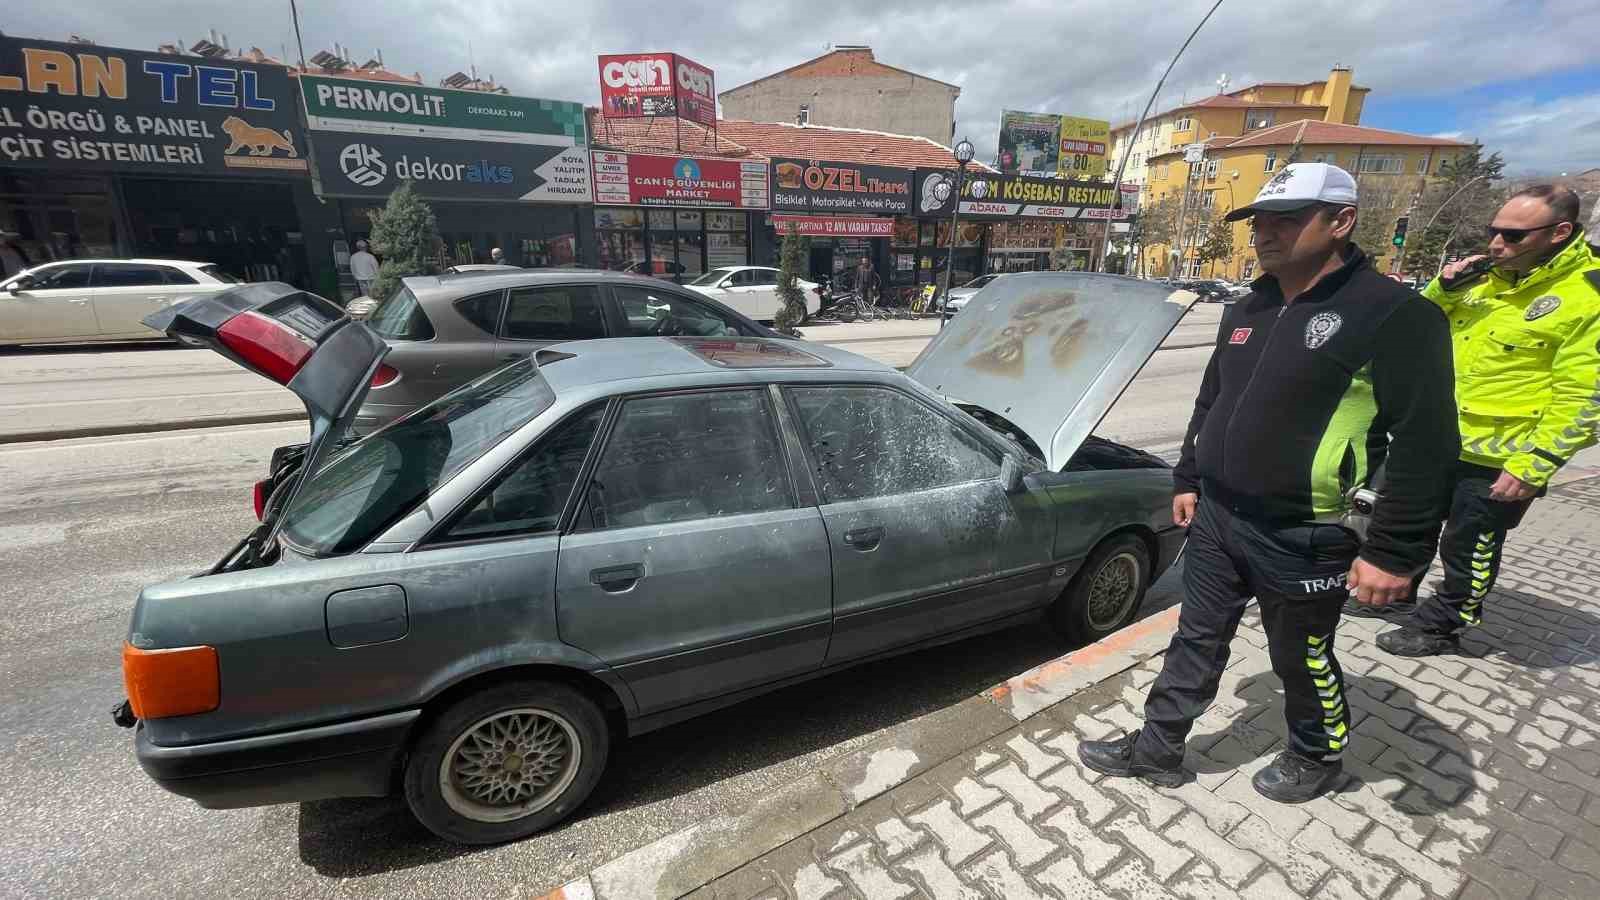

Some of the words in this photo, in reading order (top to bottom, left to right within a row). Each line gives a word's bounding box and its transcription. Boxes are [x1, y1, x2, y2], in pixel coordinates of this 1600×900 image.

[603, 59, 670, 88] can
[143, 60, 275, 111] TEL
[26, 105, 106, 132] ÖRGÜ
[115, 115, 134, 134] &
[137, 116, 215, 139] PANEL
[0, 133, 44, 160] ÇİT
[52, 136, 204, 164] SİSTEMLERİ
[635, 176, 661, 185] CAN
[804, 160, 867, 192] ÖZEL
[665, 189, 711, 199] MARKET
[775, 194, 807, 205] Bisiklet
[968, 203, 1007, 213] ADANA
[825, 222, 833, 232] 12
[834, 222, 847, 233] AYA
[847, 222, 870, 233] VARAN
